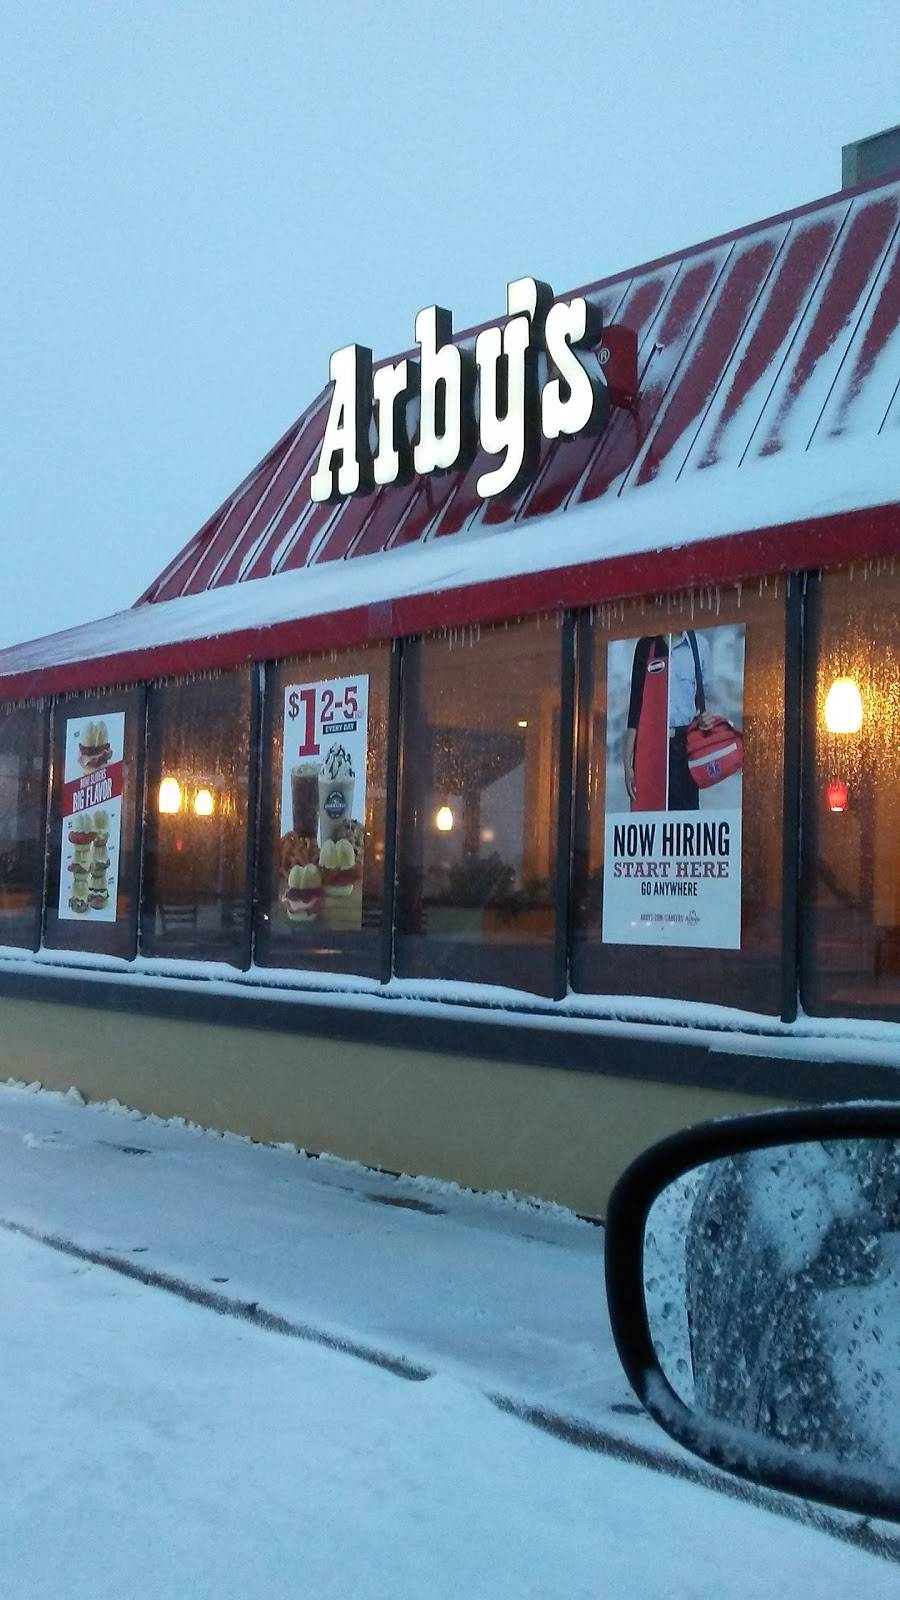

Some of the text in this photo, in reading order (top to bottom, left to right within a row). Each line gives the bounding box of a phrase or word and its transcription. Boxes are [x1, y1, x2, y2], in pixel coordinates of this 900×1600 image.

[310, 276, 595, 502] Arby's
[325, 722, 355, 733] EVERY DAY
[73, 777, 112, 813] BIG FLAVOR
[613, 822, 730, 857] NOW HIRING
[613, 861, 729, 878] START HERE
[641, 881, 698, 897] GO ANYWHERE
